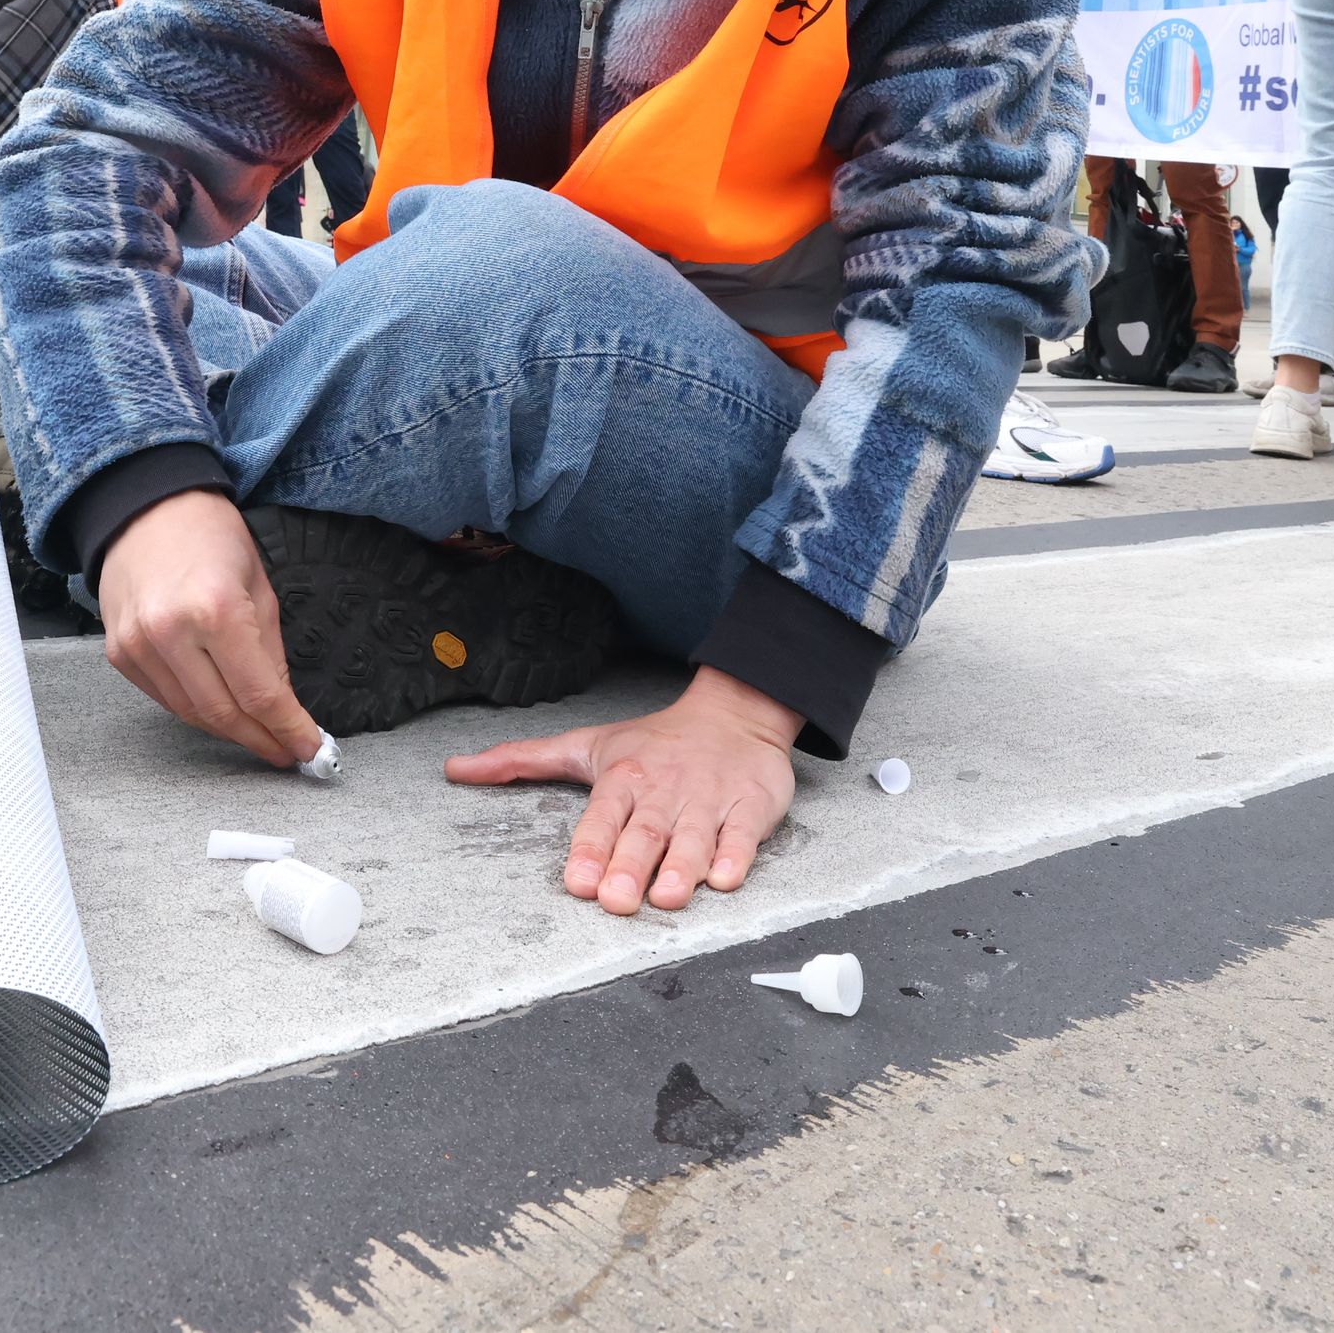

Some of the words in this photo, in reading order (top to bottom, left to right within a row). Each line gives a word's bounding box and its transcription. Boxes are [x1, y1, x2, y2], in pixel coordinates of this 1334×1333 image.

[1171, 23, 1195, 43] FOR
[1239, 22, 1285, 47] Global
[1128, 26, 1168, 106] SCIENTISTS
[1172, 88, 1211, 139] FUTURE
